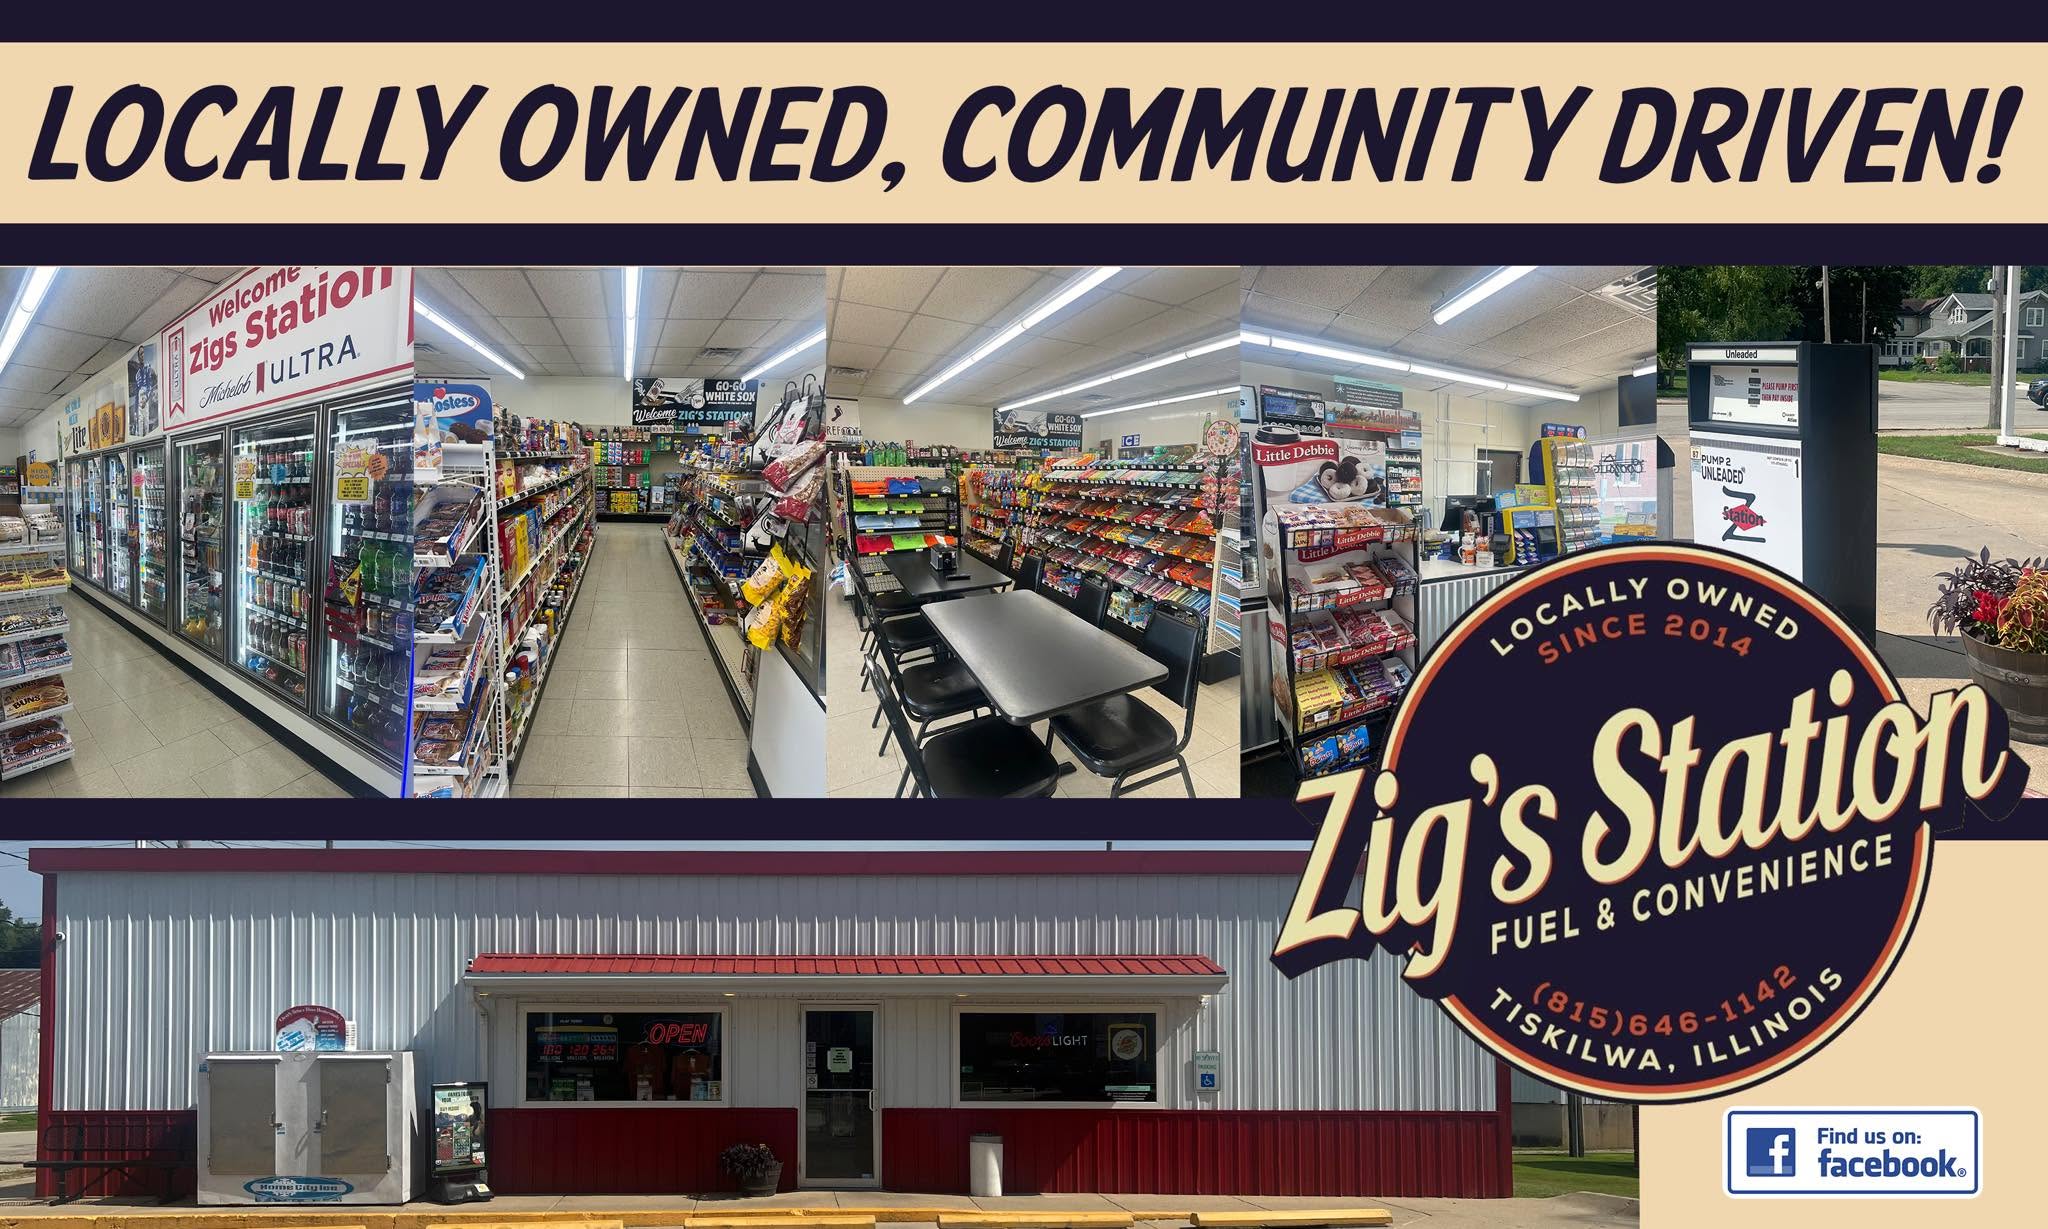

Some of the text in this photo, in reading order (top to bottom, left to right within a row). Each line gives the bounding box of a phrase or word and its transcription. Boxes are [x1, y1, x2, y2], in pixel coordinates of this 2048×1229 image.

[209, 266, 300, 328] Welcome
[190, 267, 392, 376] Zigs Station
[1726, 349, 1758, 359] Unleaded
[199, 335, 358, 409] Michelob ULTRA
[716, 381, 747, 391] GO-GO
[705, 391, 756, 402] WHITE SOX
[430, 396, 475, 413] ostess
[633, 408, 678, 423] Welcome
[678, 410, 704, 421] ZIG'S
[1054, 414, 1076, 424] GO-GO
[1048, 423, 1082, 433] WHITE SOX
[994, 435, 1081, 448] Welcome ZIG'S STATION!
[1122, 435, 1140, 446] ICE
[1256, 448, 1291, 463] Little
[1293, 443, 1335, 459] Debbie
[1701, 455, 1731, 467] PUMP 2
[1795, 458, 1799, 478] 1
[1701, 465, 1744, 484] UNLEADED
[1723, 506, 1764, 527] Station
[1337, 529, 1381, 545] Little Debbie
[1302, 547, 1330, 560] Little
[1338, 588, 1382, 605] Little Debbie
[12, 695, 41, 710] BUNS
[650, 1023, 708, 1045] OPEN
[1052, 1034, 1088, 1047] LIGHT
